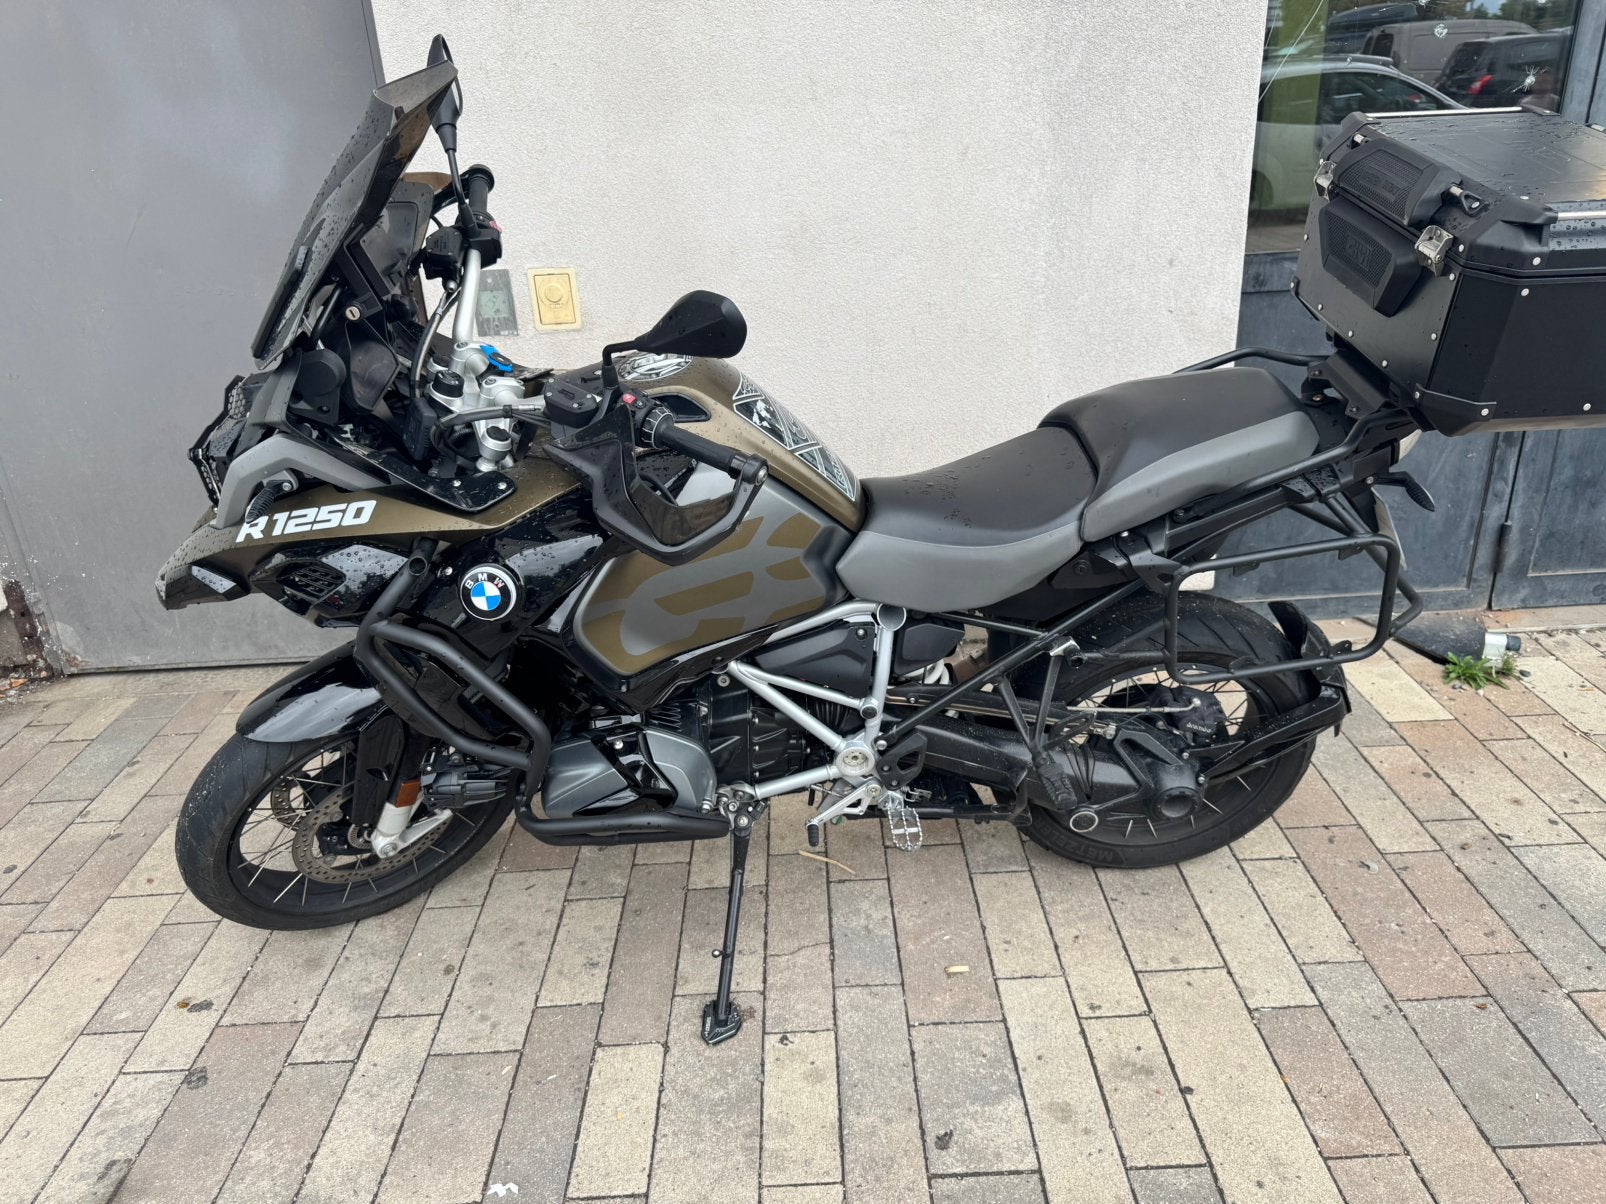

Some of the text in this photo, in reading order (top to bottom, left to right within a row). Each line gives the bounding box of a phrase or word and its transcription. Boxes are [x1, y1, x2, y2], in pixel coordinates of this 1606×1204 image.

[236, 500, 377, 542] R 1250
[465, 573, 504, 589] BMW
